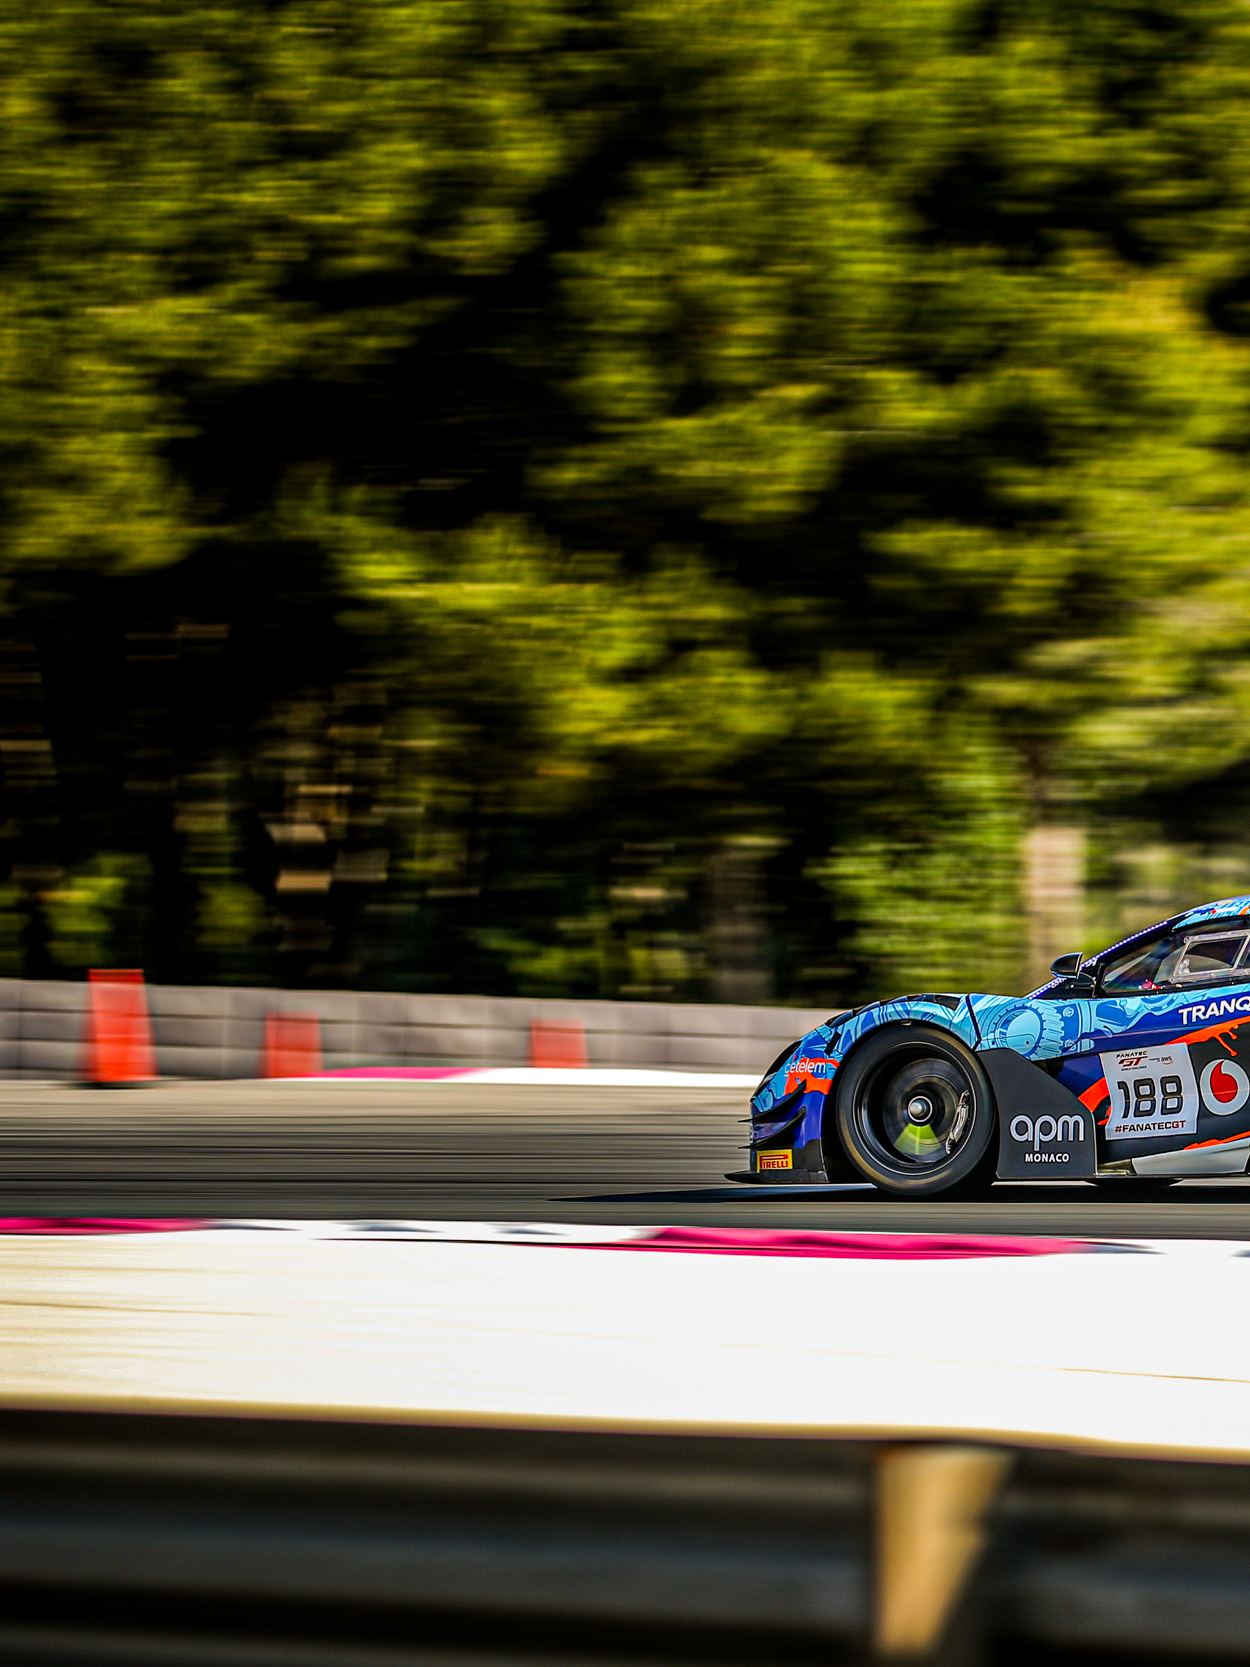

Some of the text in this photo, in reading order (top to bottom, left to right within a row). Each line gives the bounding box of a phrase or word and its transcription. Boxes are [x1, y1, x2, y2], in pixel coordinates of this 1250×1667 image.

[1116, 1050, 1148, 1059] FANATEC
[1118, 1056, 1149, 1067] GT
[784, 1057, 826, 1075] cetelem
[1116, 1075, 1183, 1119] 188
[1009, 1114, 1084, 1152] apm
[1114, 1120, 1187, 1133] #FANATECGT
[759, 1154, 789, 1169] PIRELLI
[1024, 1153, 1070, 1163] MONACO
